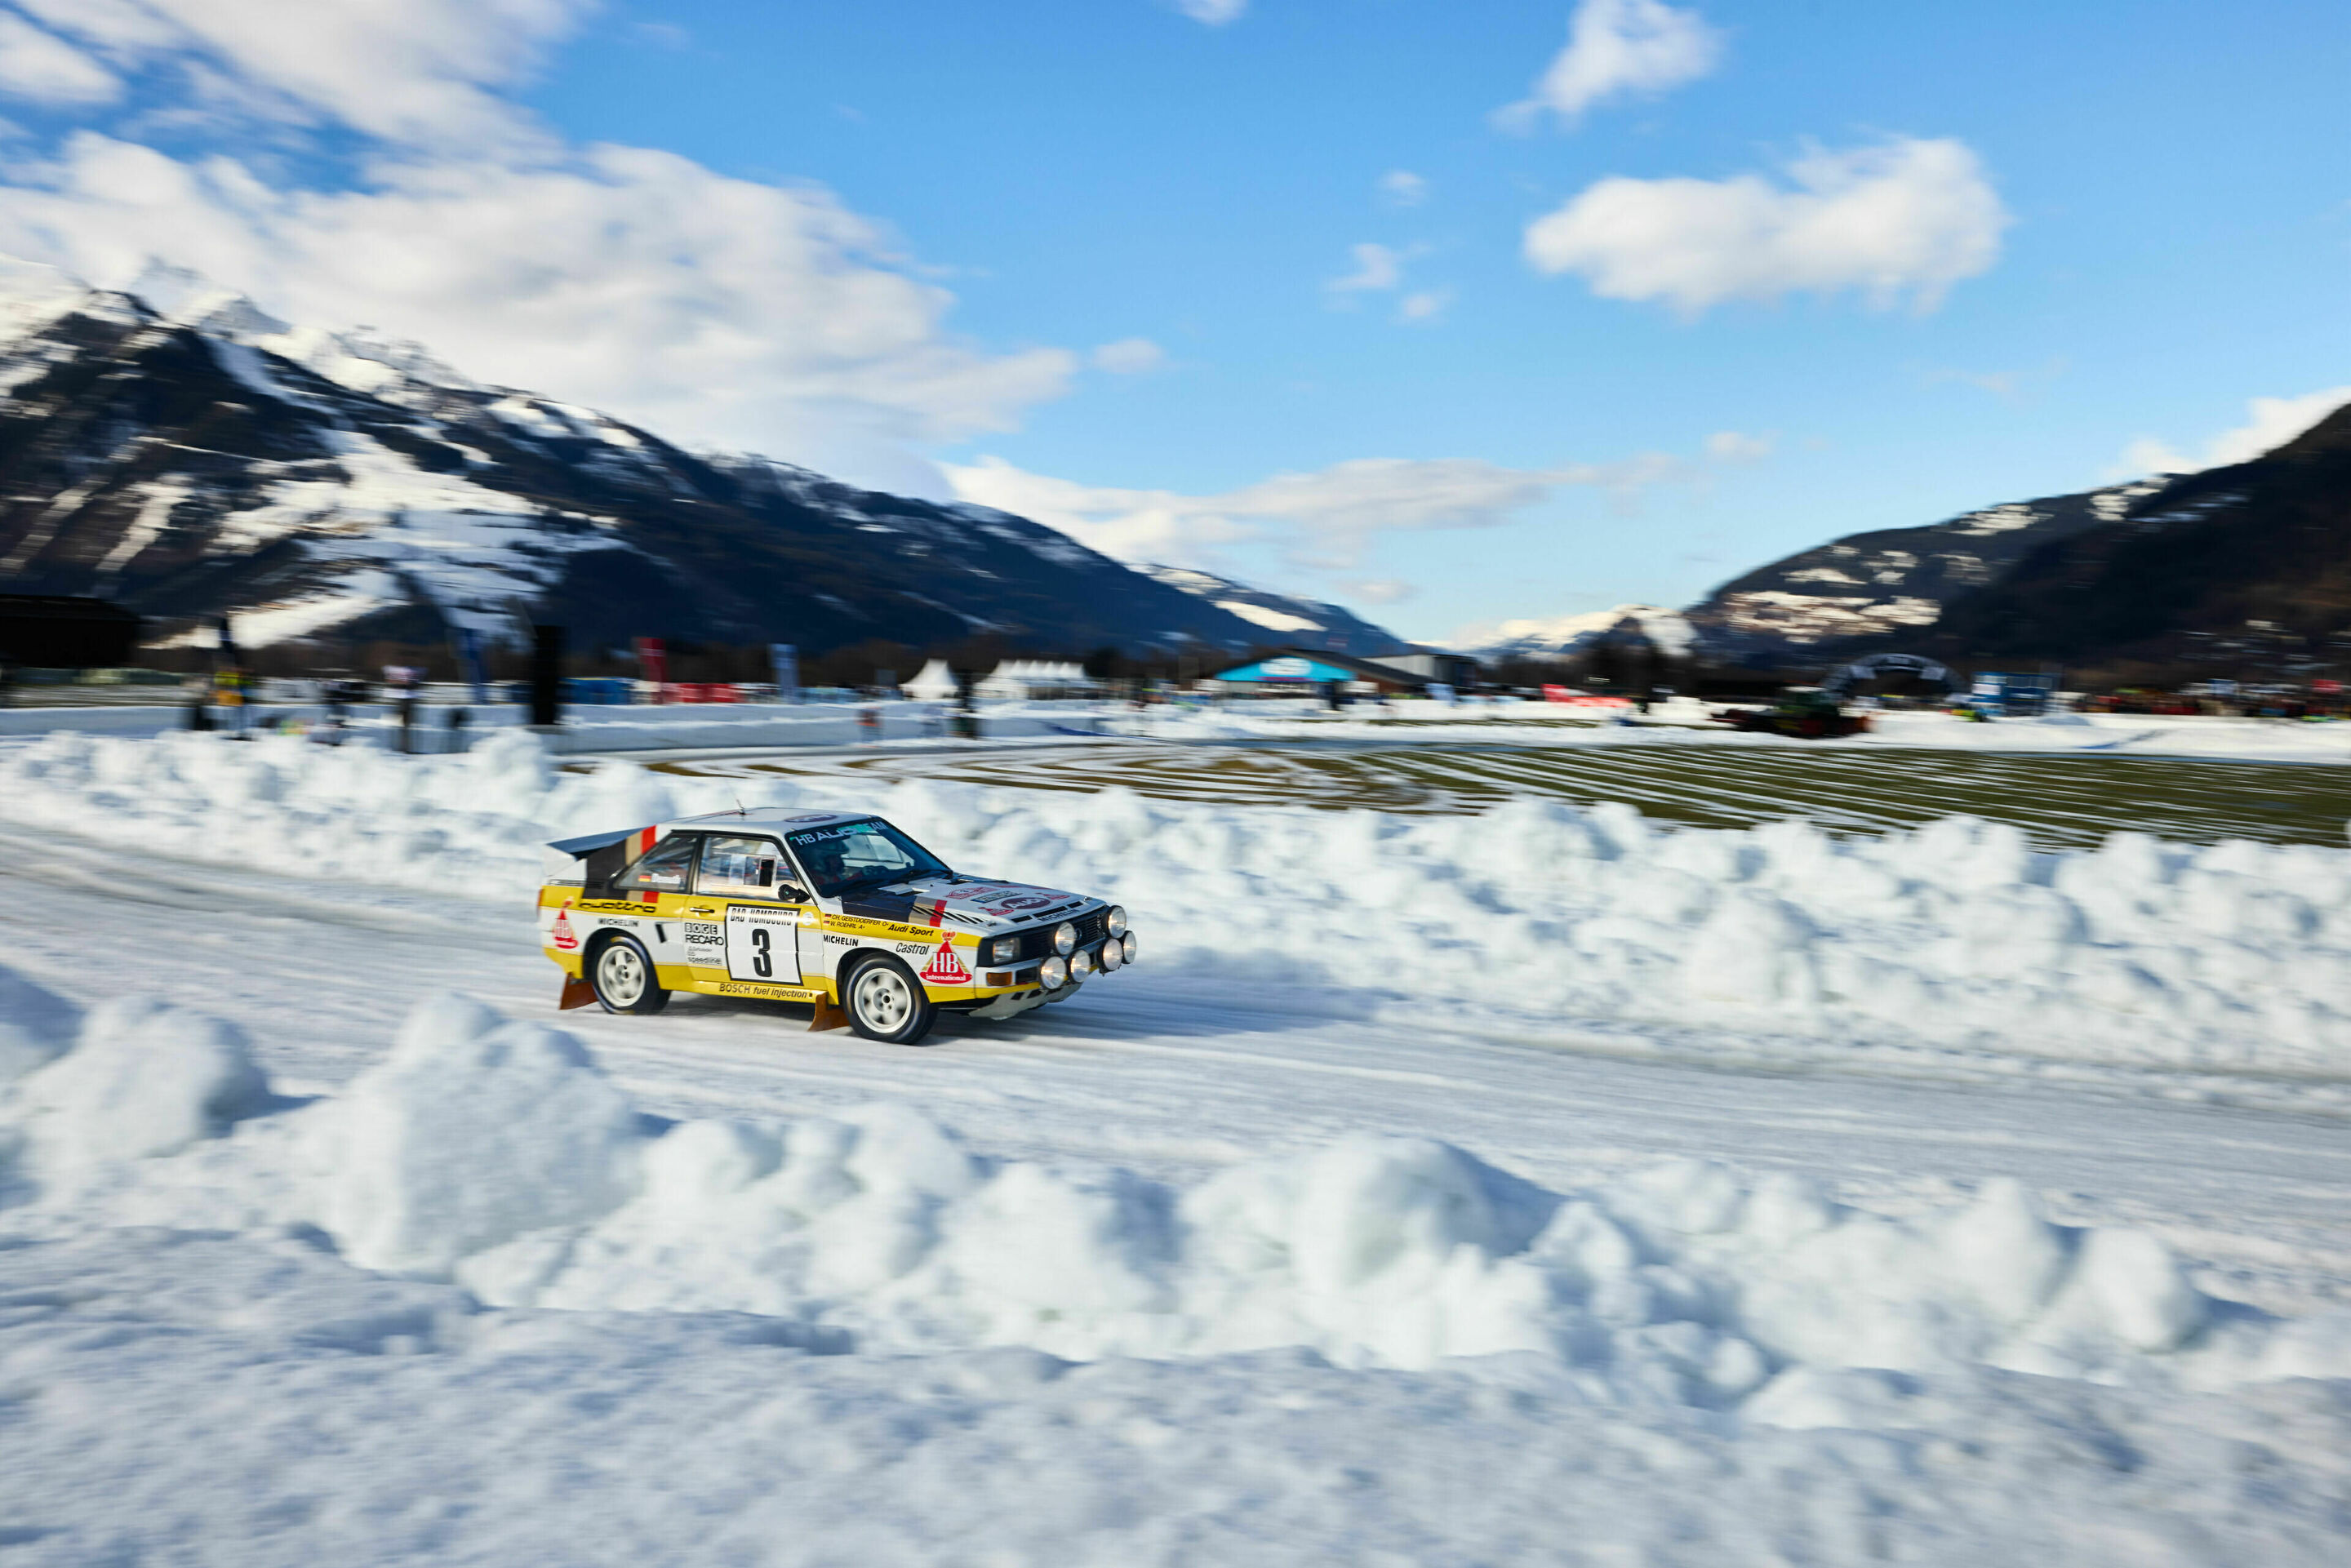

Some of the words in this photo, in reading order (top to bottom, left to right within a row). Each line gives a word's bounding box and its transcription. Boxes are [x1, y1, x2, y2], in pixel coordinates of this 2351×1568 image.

[795, 833, 816, 846] HB
[579, 902, 656, 913] quattro
[841, 915, 882, 926] GEISTDOERFER
[1037, 908, 1080, 922] MICHELIN
[598, 917, 639, 927] MICHELIN
[685, 922, 718, 935] BOGE
[838, 922, 857, 930] ROEHRL
[888, 924, 909, 933] Audi
[909, 926, 935, 937] Sport
[685, 934, 725, 946] RECARO
[823, 934, 859, 947] MICHELIN
[752, 928, 773, 978] 3
[896, 942, 930, 956] Castrol
[932, 952, 958, 974] HB
[925, 973, 967, 982] international
[719, 983, 751, 994] BOSCH
[753, 986, 770, 996] fuel
[771, 988, 808, 999] injection
